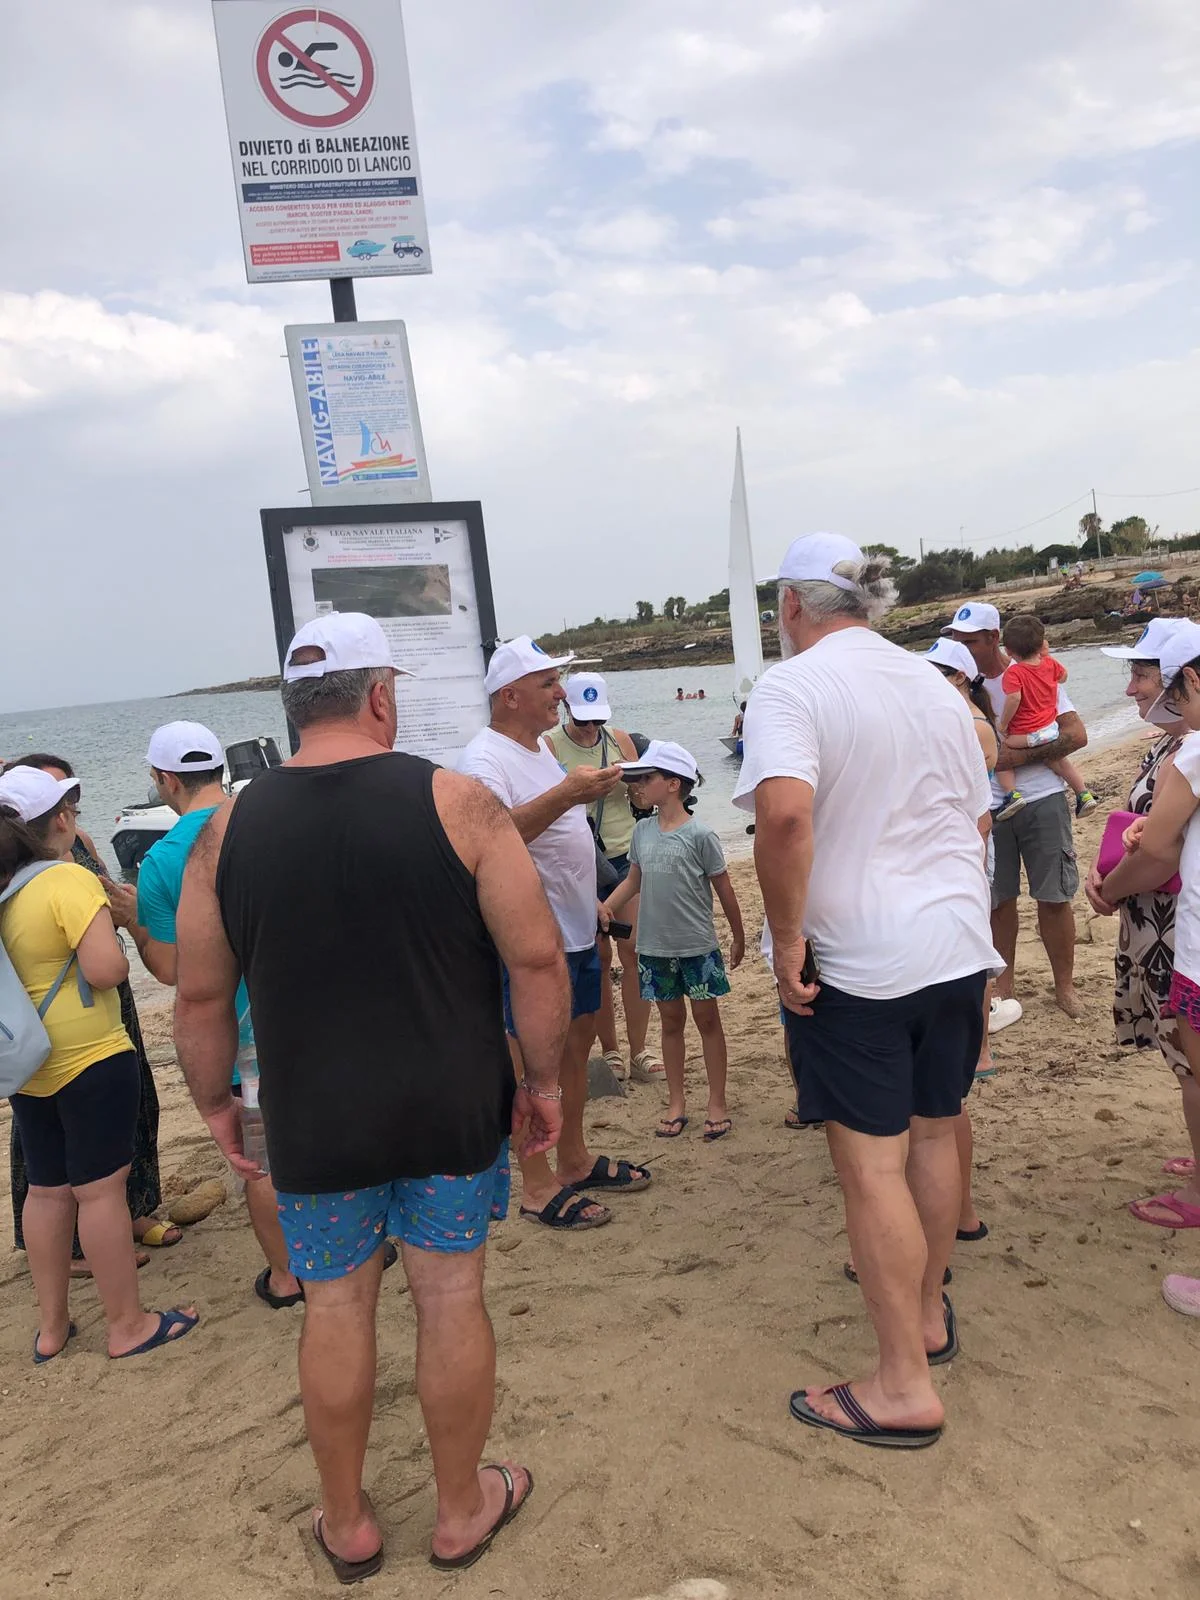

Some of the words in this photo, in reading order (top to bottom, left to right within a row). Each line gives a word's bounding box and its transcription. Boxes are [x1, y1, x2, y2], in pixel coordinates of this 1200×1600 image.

[239, 139, 293, 156] DIVIETO
[298, 140, 311, 154] di
[316, 135, 410, 153] BALNEAZIONE
[242, 160, 268, 177] NEL
[271, 158, 343, 176] CORRIDOIO
[348, 157, 361, 173] DI
[365, 155, 412, 172] LANCIO
[249, 205, 274, 213] ACCESSO
[275, 203, 311, 212] CONSENTITO
[312, 202, 326, 210] SOLO
[338, 201, 353, 209] VARO
[363, 200, 387, 208] ALAGGIO
[388, 199, 412, 207] NATANTI
[301, 338, 340, 486] NAVIG-ABILE
[352, 529, 386, 537] NAVALE
